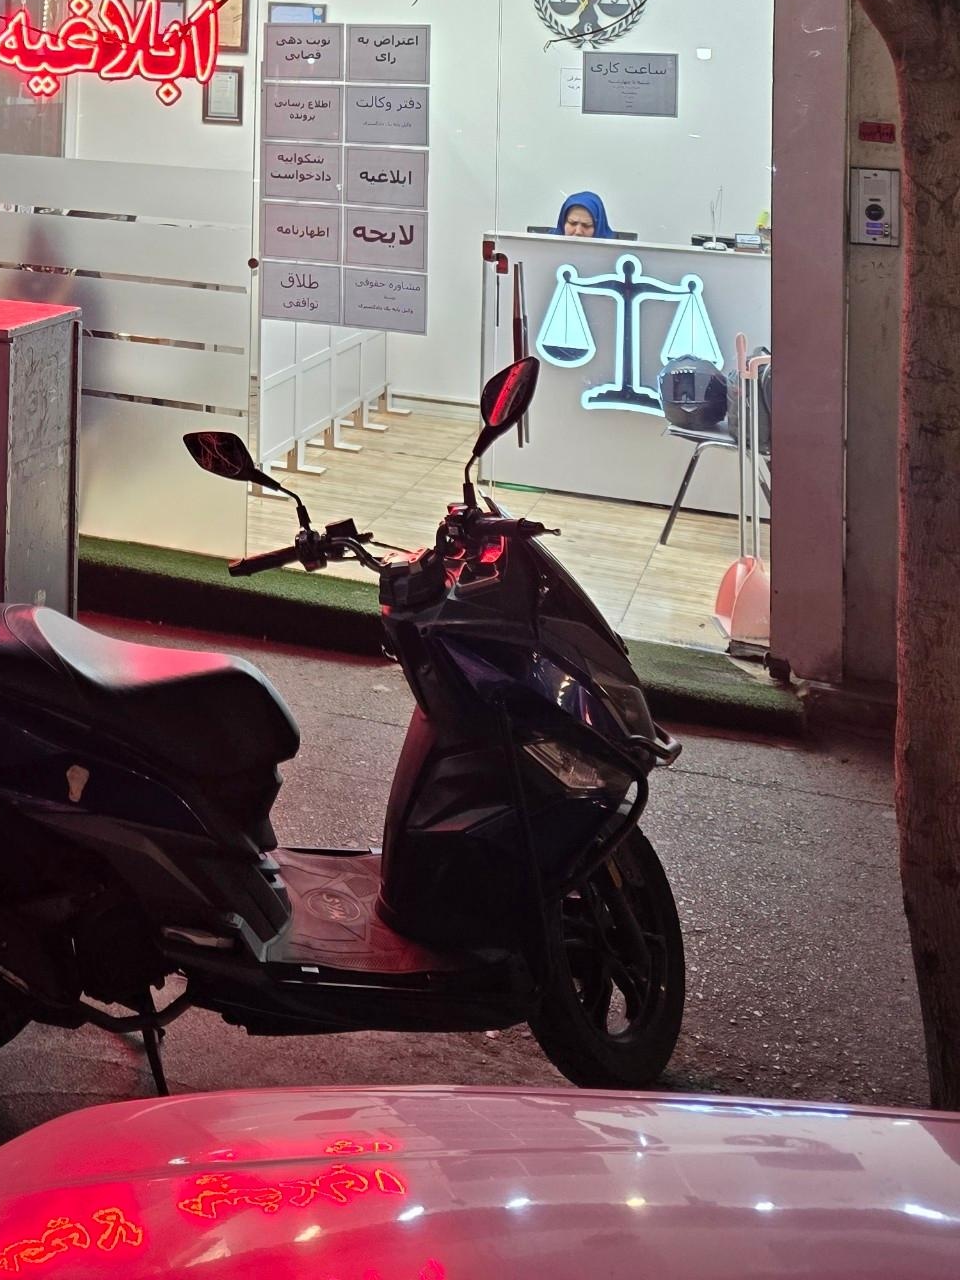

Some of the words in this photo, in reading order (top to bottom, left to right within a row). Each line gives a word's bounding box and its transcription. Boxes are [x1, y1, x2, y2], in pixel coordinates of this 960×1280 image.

[583, 23, 593, 34] 6
[275, 36, 303, 47] دهی
[357, 35, 370, 46] به
[373, 34, 419, 48] اعتراض
[375, 51, 397, 65] رای
[590, 61, 620, 76] کاری
[624, 62, 667, 75] ساعت
[274, 99, 305, 110] رسانی
[307, 99, 331, 110] اطلاع
[355, 95, 393, 112] وکالت
[396, 96, 422, 112] دفتر
[270, 169, 332, 183] دادخواست
[359, 169, 412, 187] ابلاغیه
[276, 224, 330, 239] اظهارنامه
[352, 224, 415, 248] لایحه
[279, 270, 319, 291] طلاق
[354, 277, 385, 289] حقوقی
[388, 280, 421, 292] مشاوره
[282, 296, 319, 311] توافقی
